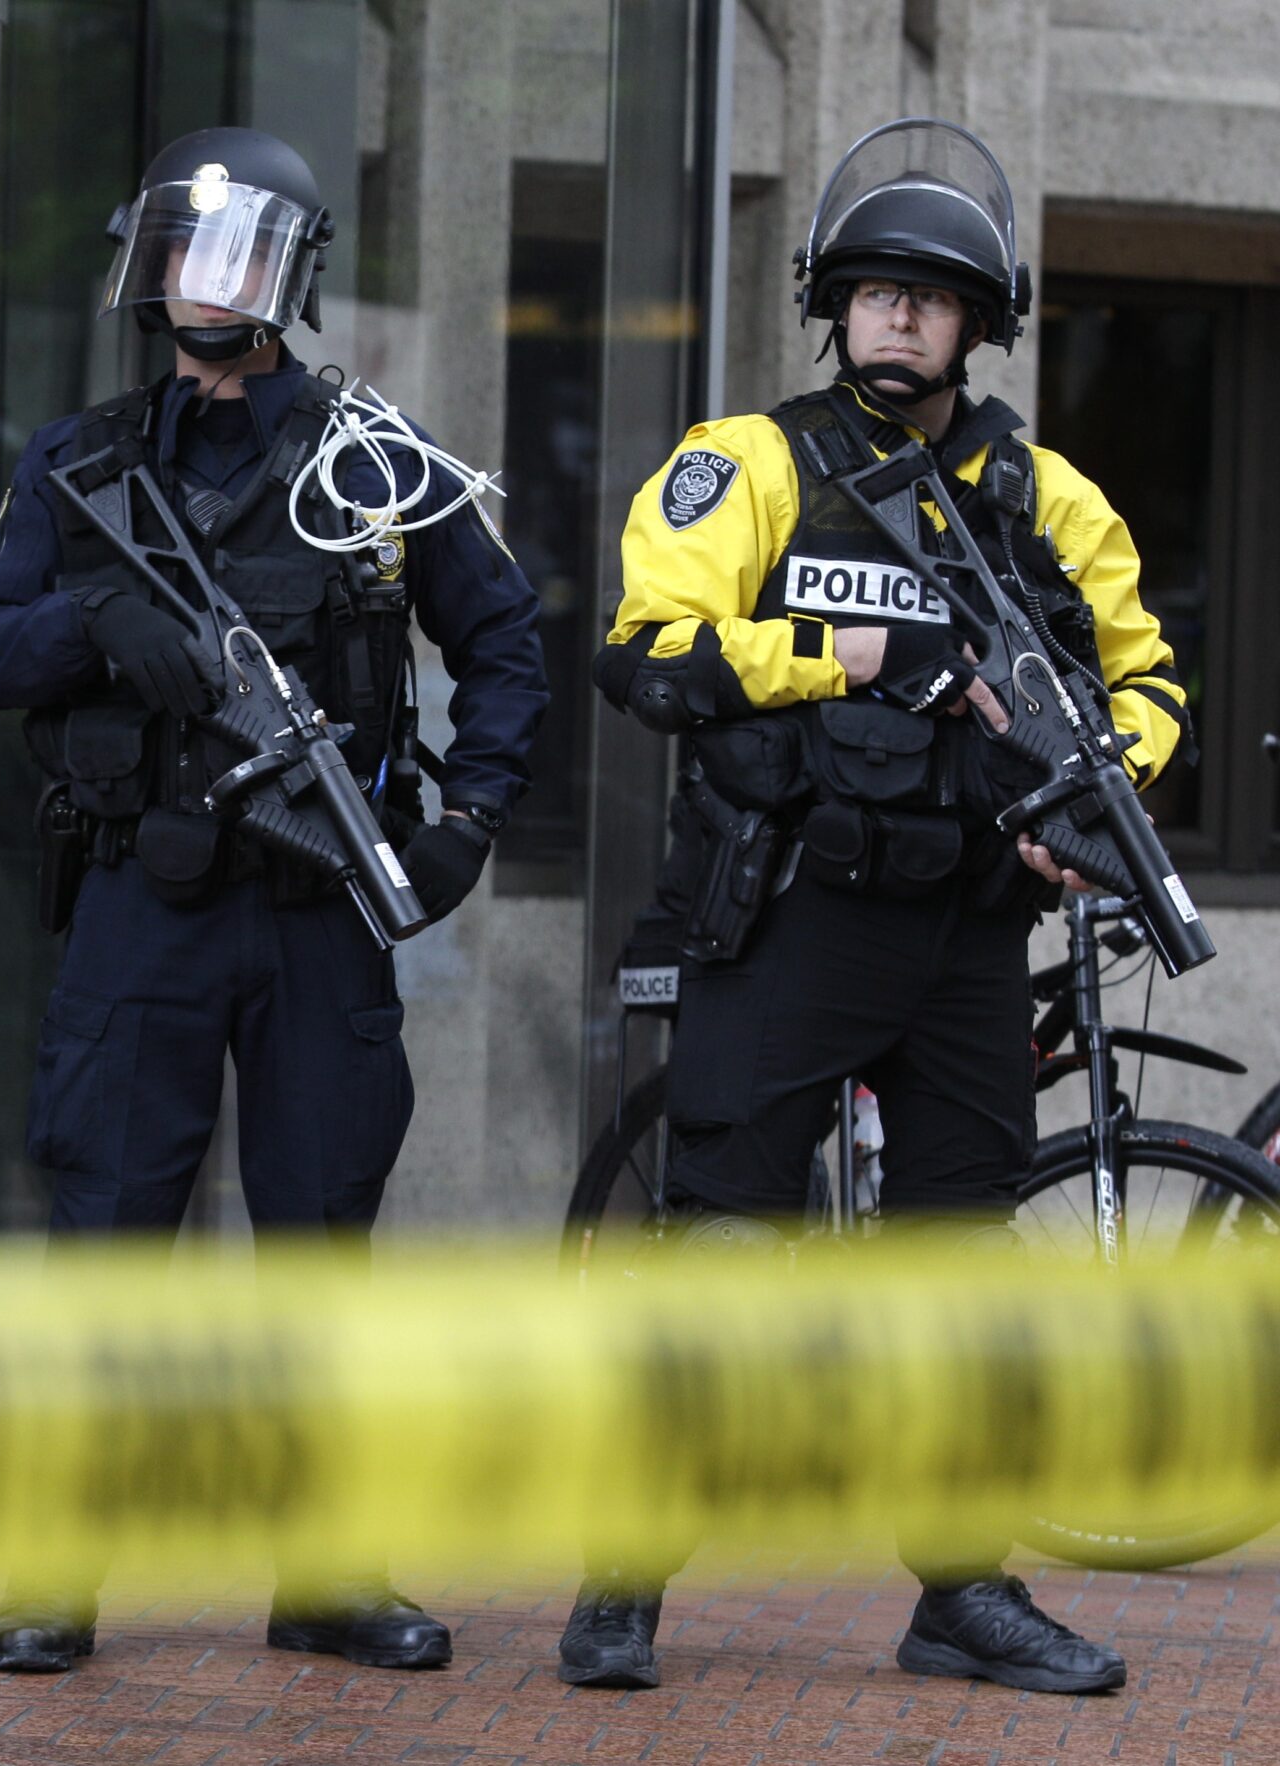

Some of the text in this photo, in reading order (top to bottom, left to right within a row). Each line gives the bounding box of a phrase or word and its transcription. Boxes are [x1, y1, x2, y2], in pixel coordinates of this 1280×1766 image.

[682, 453, 734, 475] POLICE
[796, 564, 941, 615] POLICE
[623, 976, 674, 997] POLICE
